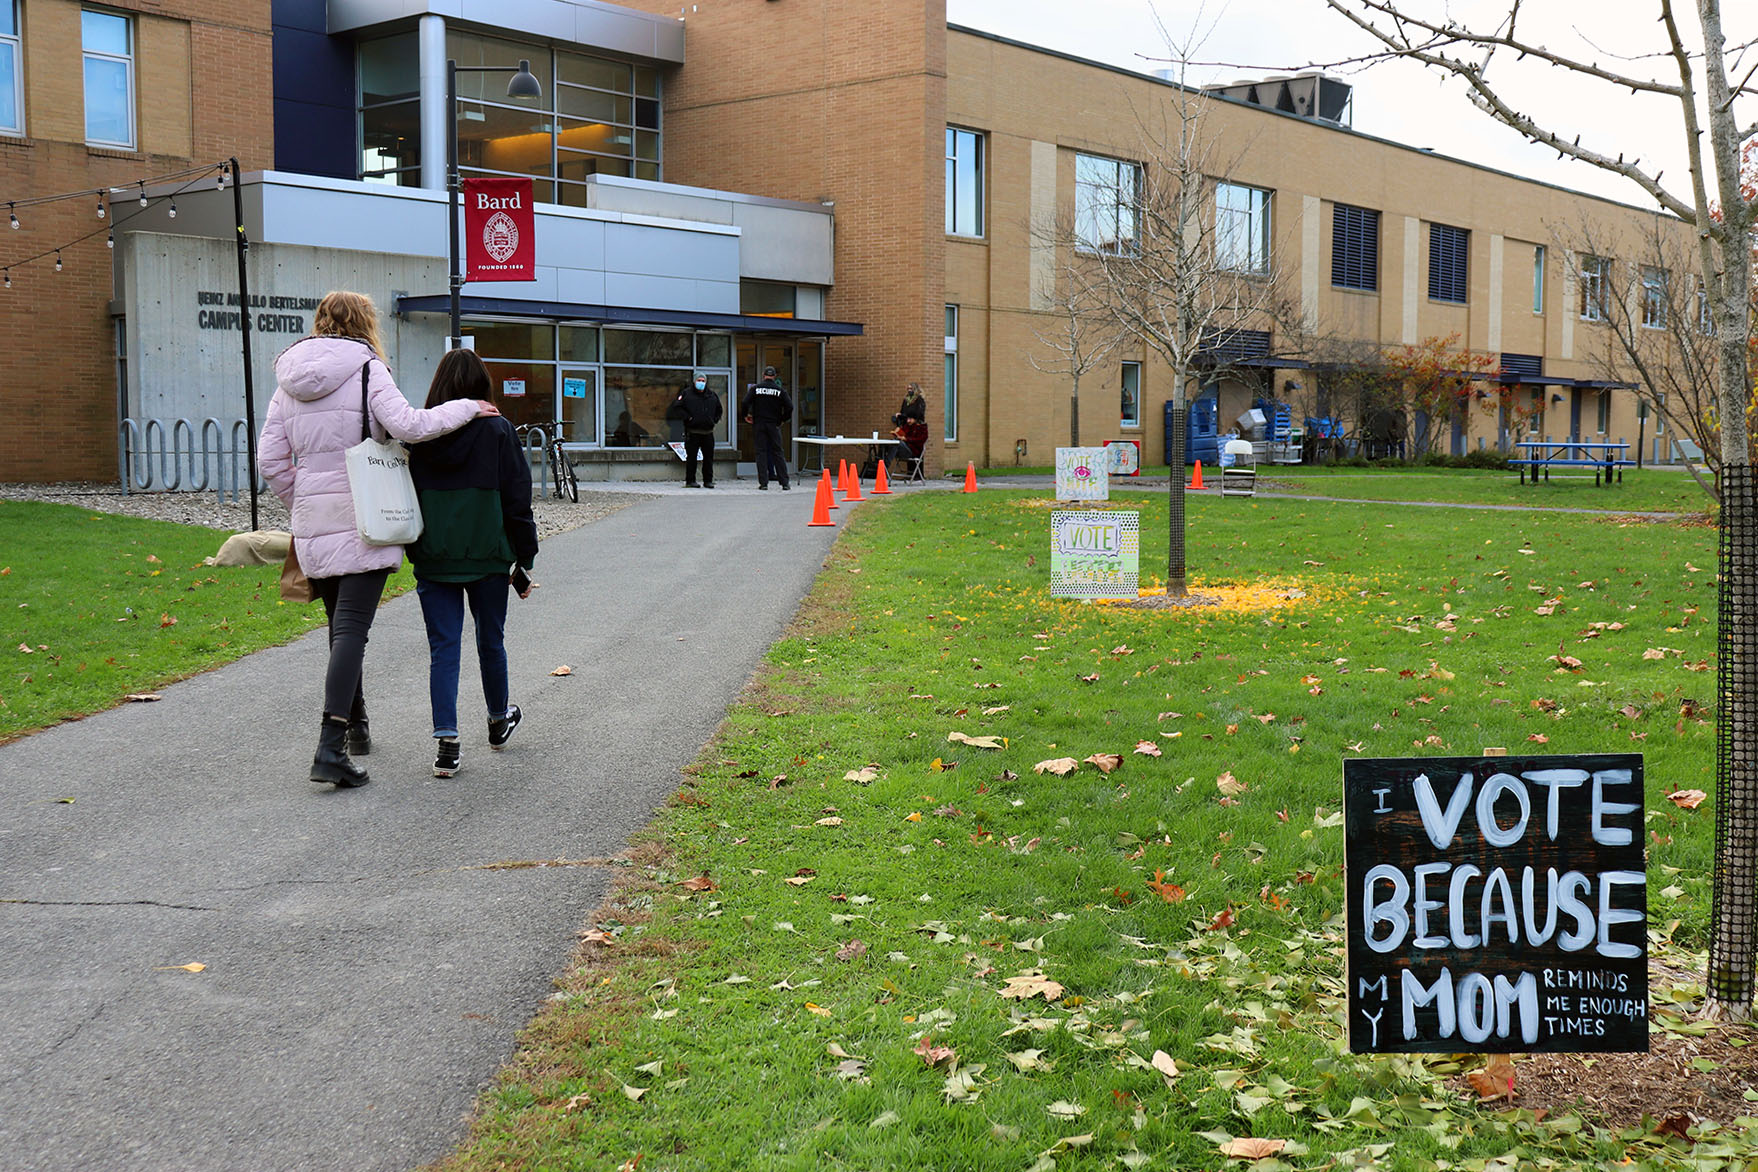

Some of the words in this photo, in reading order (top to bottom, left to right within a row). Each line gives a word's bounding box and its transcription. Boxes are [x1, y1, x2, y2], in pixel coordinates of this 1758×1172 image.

[476, 191, 522, 209] Bard
[198, 292, 224, 306] HEINZ
[257, 313, 304, 334] CENTER
[755, 387, 781, 397] SECURITY
[1065, 455, 1093, 470] VOTE
[1070, 525, 1114, 550] VOTE
[1372, 788, 1393, 814] I
[1412, 768, 1641, 850] VOTE
[1363, 862, 1647, 959] BECAUSE
[1543, 968, 1629, 993] REMINDS
[1401, 966, 1539, 1044] MOM
[1546, 996, 1571, 1011] ME
[1579, 996, 1646, 1022] ENOUGH
[1544, 1016, 1606, 1037] TIMES
